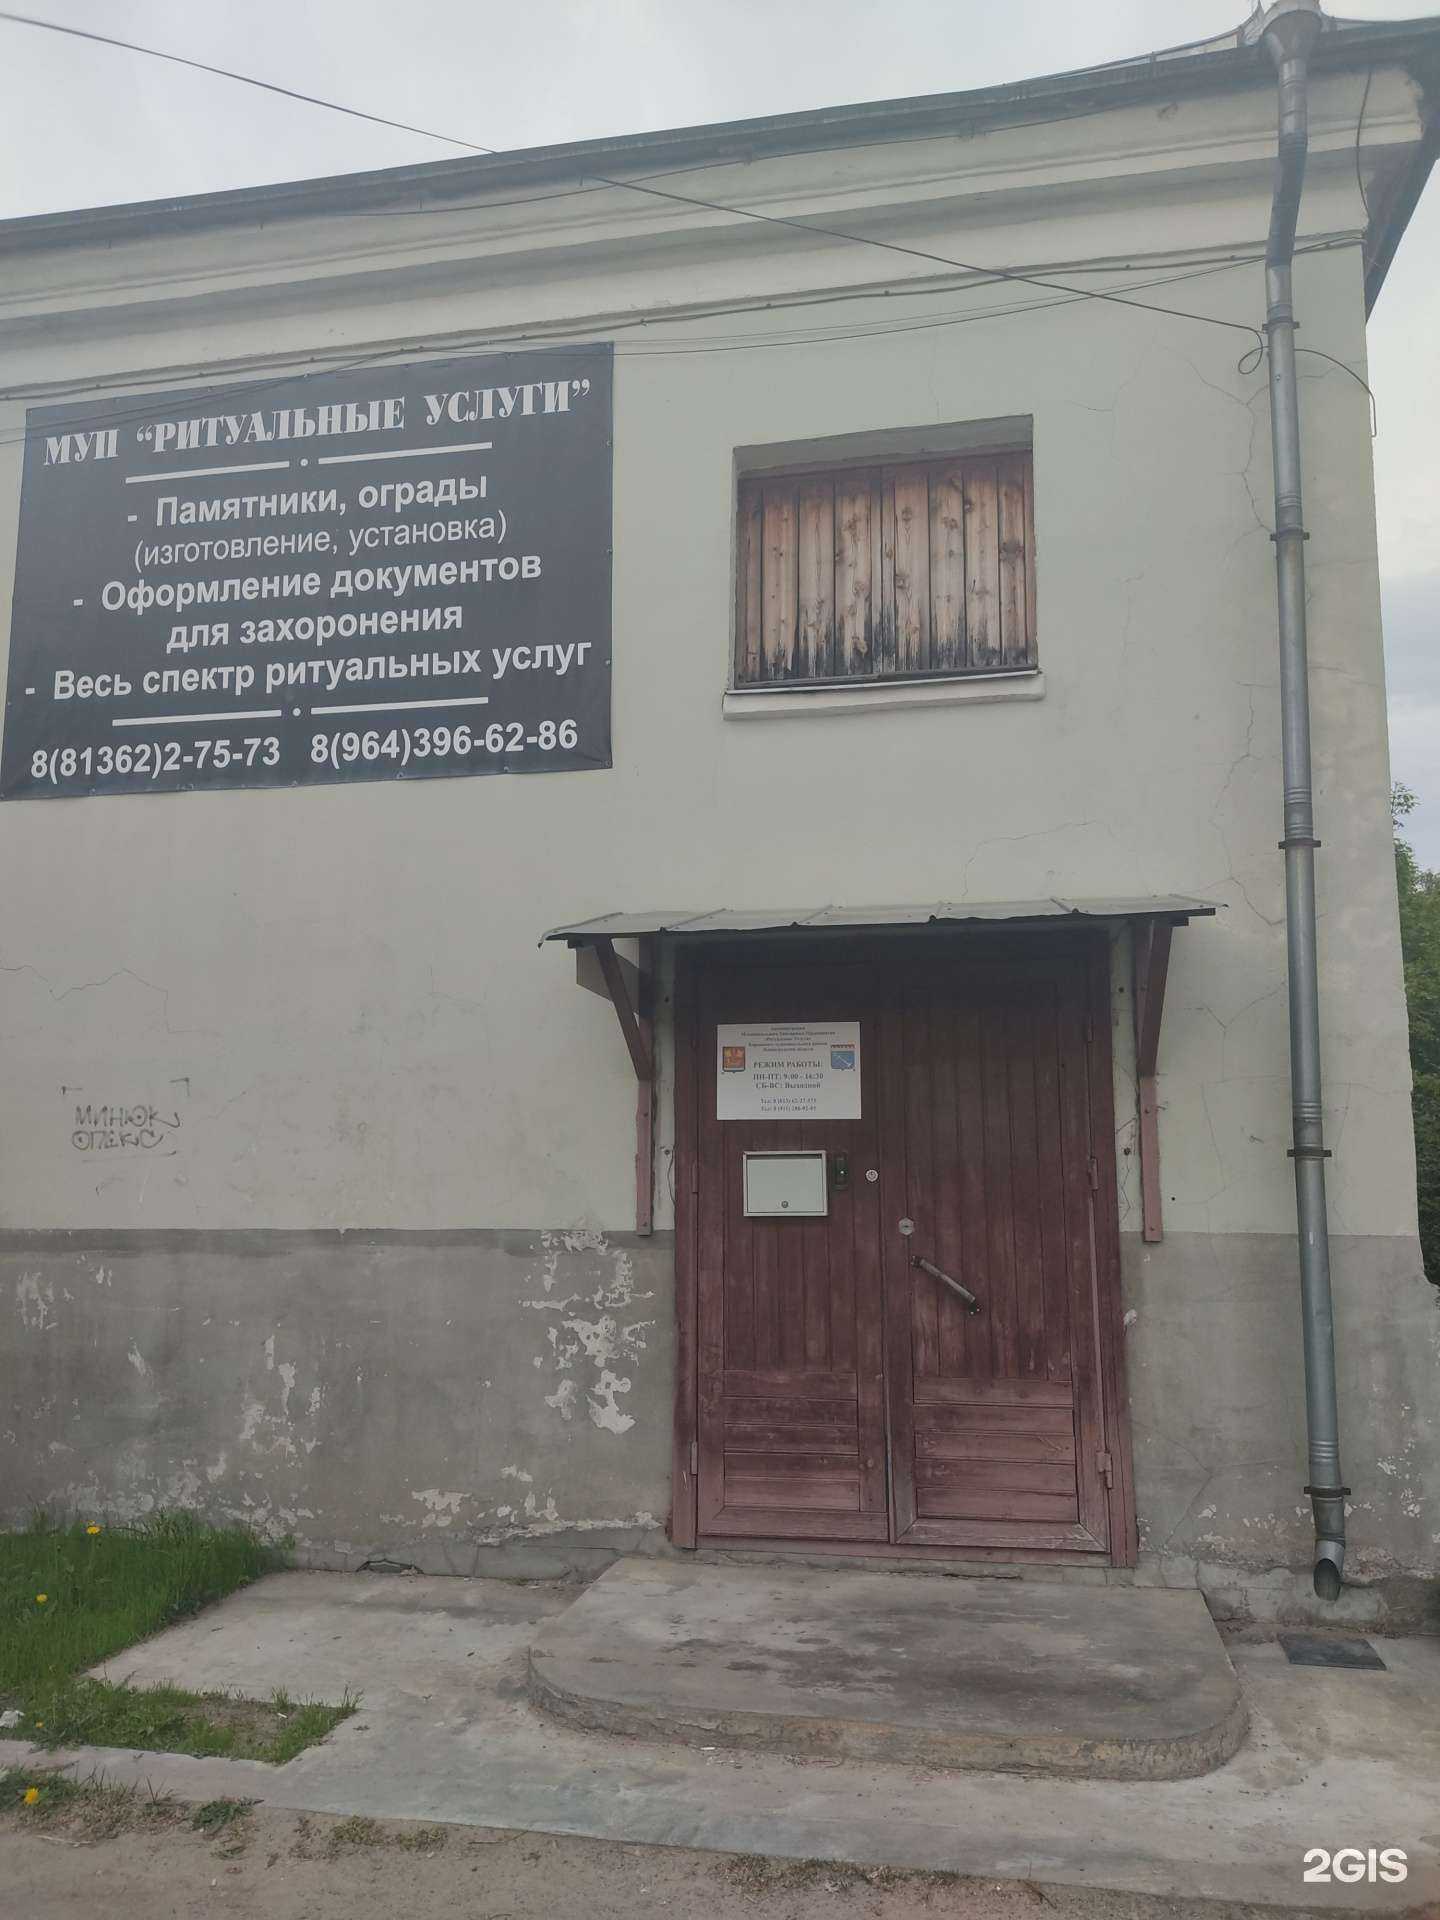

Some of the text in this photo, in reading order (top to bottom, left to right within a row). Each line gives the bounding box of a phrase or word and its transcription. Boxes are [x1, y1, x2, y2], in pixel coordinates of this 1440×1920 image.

[43, 428, 120, 466] МУП
[156, 489, 346, 527] Памятники,
[358, 475, 487, 513] ограды
[134, 510, 508, 573] (изготовление, установка)
[101, 574, 322, 615] Оформление
[330, 553, 543, 599] документов
[166, 606, 463, 654] для захоронения
[53, 670, 132, 700] Весь
[142, 664, 255, 696] спектр
[264, 646, 481, 692] ритуальных
[491, 641, 592, 680] услуг
[30, 719, 578, 784] 8(81362)2-75-73 8(964)396-62-86
